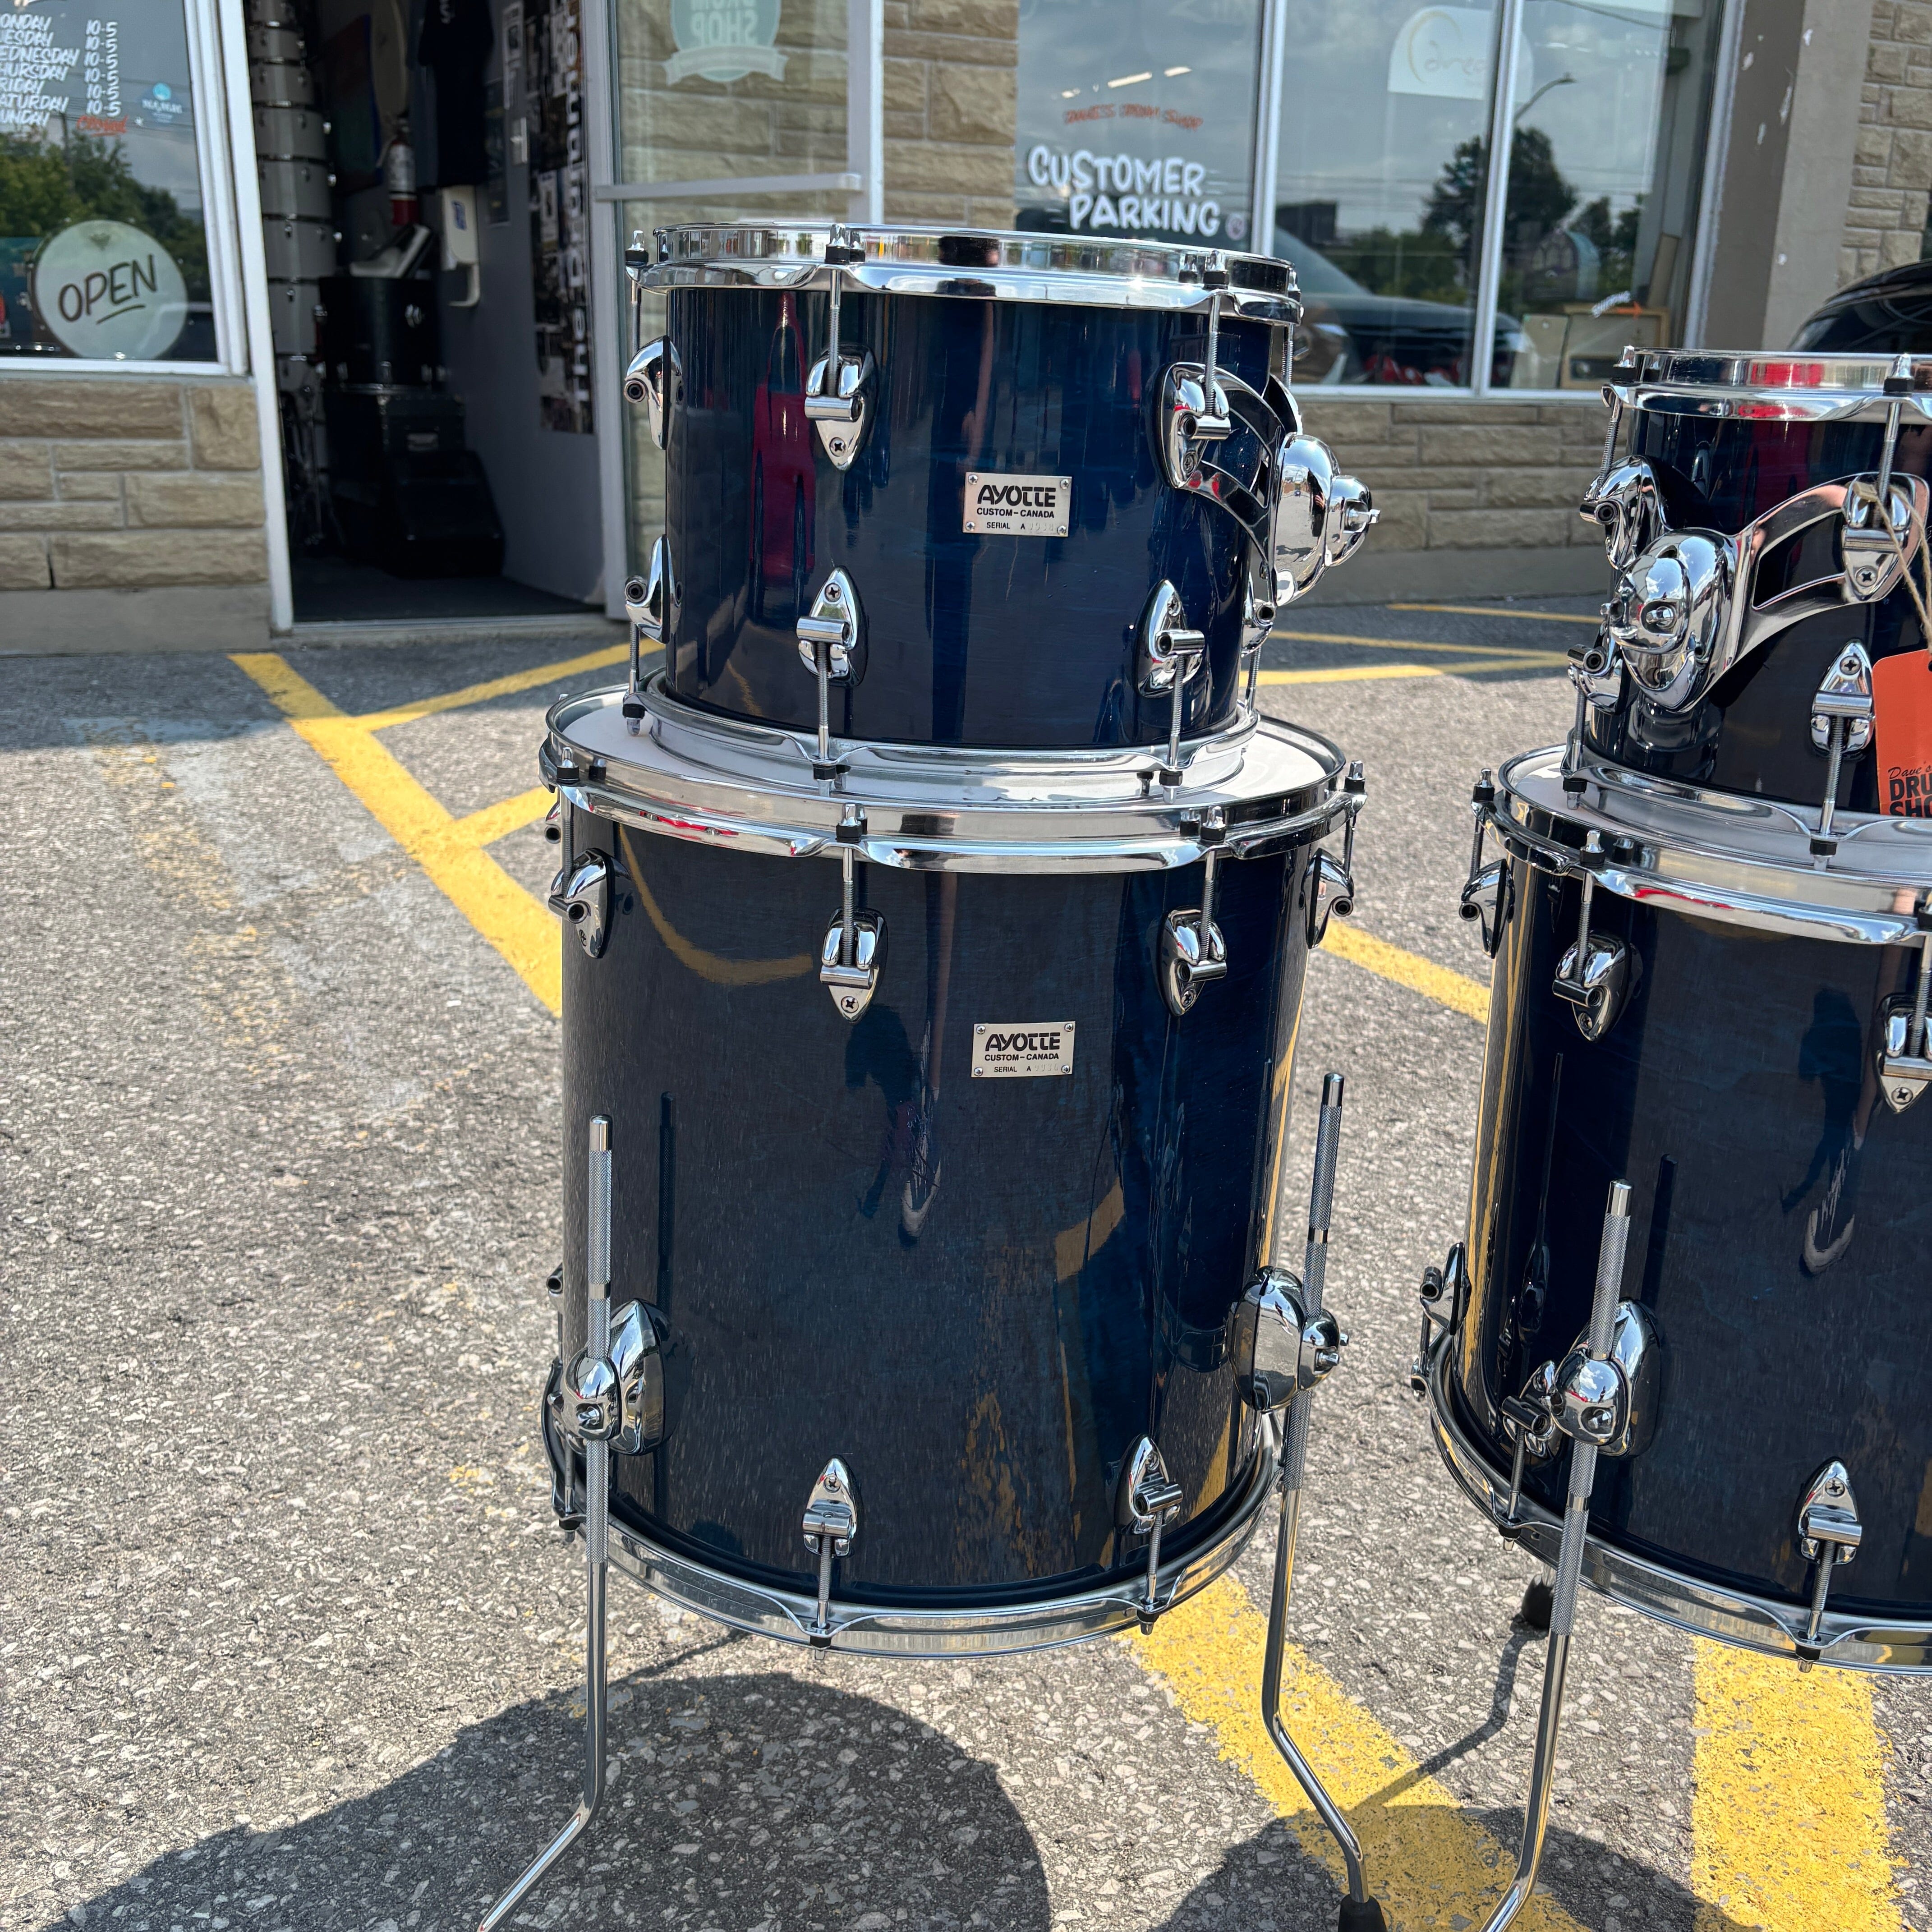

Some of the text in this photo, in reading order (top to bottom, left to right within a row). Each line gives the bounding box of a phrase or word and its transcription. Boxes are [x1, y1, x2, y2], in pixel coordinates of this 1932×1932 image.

[86, 19, 118, 37] 10-5
[85, 36, 117, 53] 10-5
[84, 51, 118, 69] 10-5
[85, 68, 119, 86] 10-5
[86, 83, 119, 101] 10-5
[86, 100, 122, 117] 10-5
[1028, 145, 1206, 197] CUSTOMER
[1069, 193, 1220, 237] PARKING
[58, 254, 157, 322] OPEN
[977, 484, 1056, 507] AYOTTE
[985, 1032, 1061, 1052] AYOTTE
